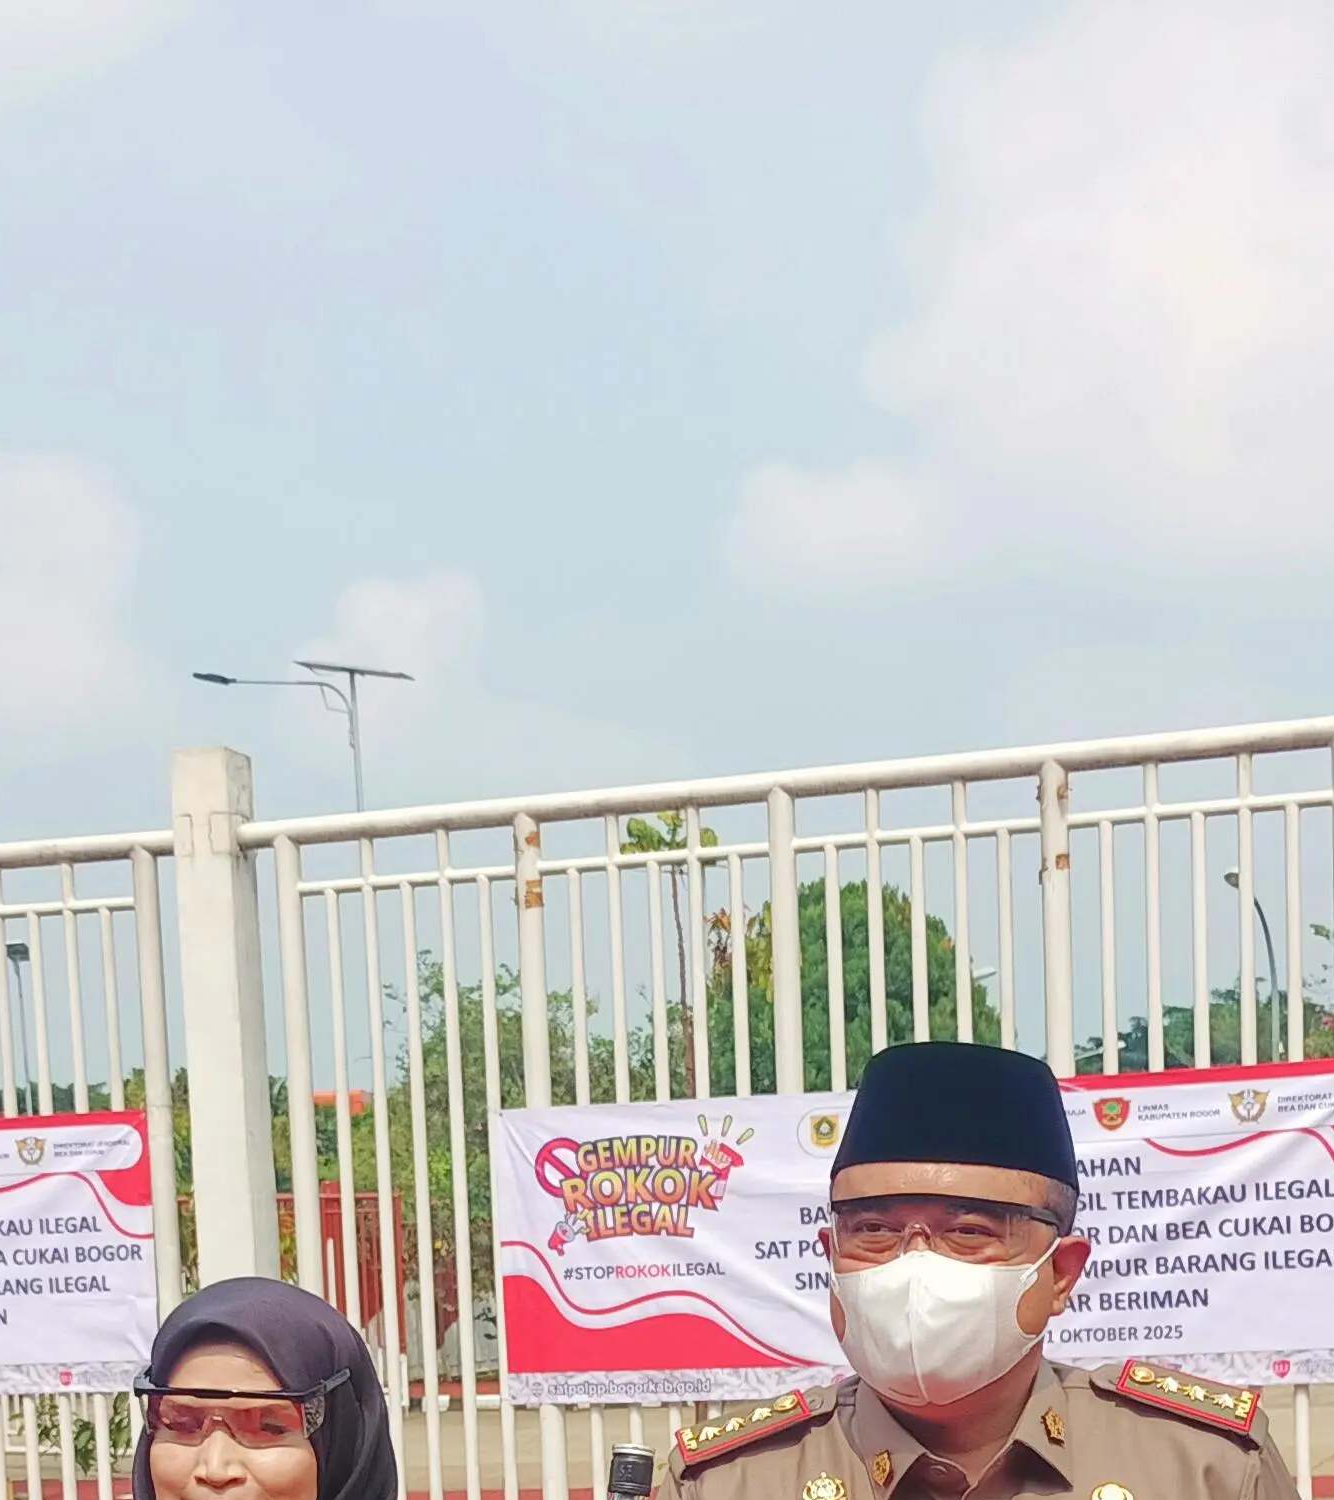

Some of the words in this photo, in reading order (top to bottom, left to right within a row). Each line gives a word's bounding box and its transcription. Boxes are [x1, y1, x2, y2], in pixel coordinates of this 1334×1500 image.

[1137, 1103, 1169, 1112] LINMAS
[1277, 1092, 1333, 1104] DIREKTORAT
[1277, 1104, 1297, 1113] BEA
[1299, 1102, 1317, 1112] DAN
[1137, 1111, 1187, 1121] KABUPATEN
[1189, 1109, 1221, 1118] BOGOR
[577, 1135, 699, 1172] GEMPUR
[1076, 1156, 1142, 1178] AHAN
[560, 1166, 720, 1214] ROKOK
[1077, 1194, 1108, 1212] SIL
[1116, 1182, 1247, 1210] TEMBAKAU
[39, 1216, 102, 1235] ILEGAL
[581, 1204, 695, 1242] ILEGAL
[799, 1206, 829, 1225] BA
[1108, 1223, 1158, 1244] DAN
[1165, 1220, 1212, 1241] BEA
[1218, 1216, 1292, 1238] CUKAI
[12, 1247, 69, 1266] CUKAI
[75, 1244, 143, 1264] BOGOR
[754, 1240, 792, 1260] SAT
[798, 1239, 826, 1258] PO
[563, 1262, 726, 1281] #STOPROKOKILEGAL
[1082, 1258, 1149, 1280] MPUR
[1155, 1251, 1257, 1275] BARANG
[49, 1275, 111, 1294] ILEGAL
[795, 1271, 832, 1290] SIN
[1064, 1293, 1093, 1313] AR
[1099, 1288, 1209, 1312] BERIMAN
[1059, 1326, 1139, 1344] OKTOBER
[1143, 1323, 1184, 1341] 2025
[547, 1379, 713, 1397] satpolpp.bogorkab.go.id
